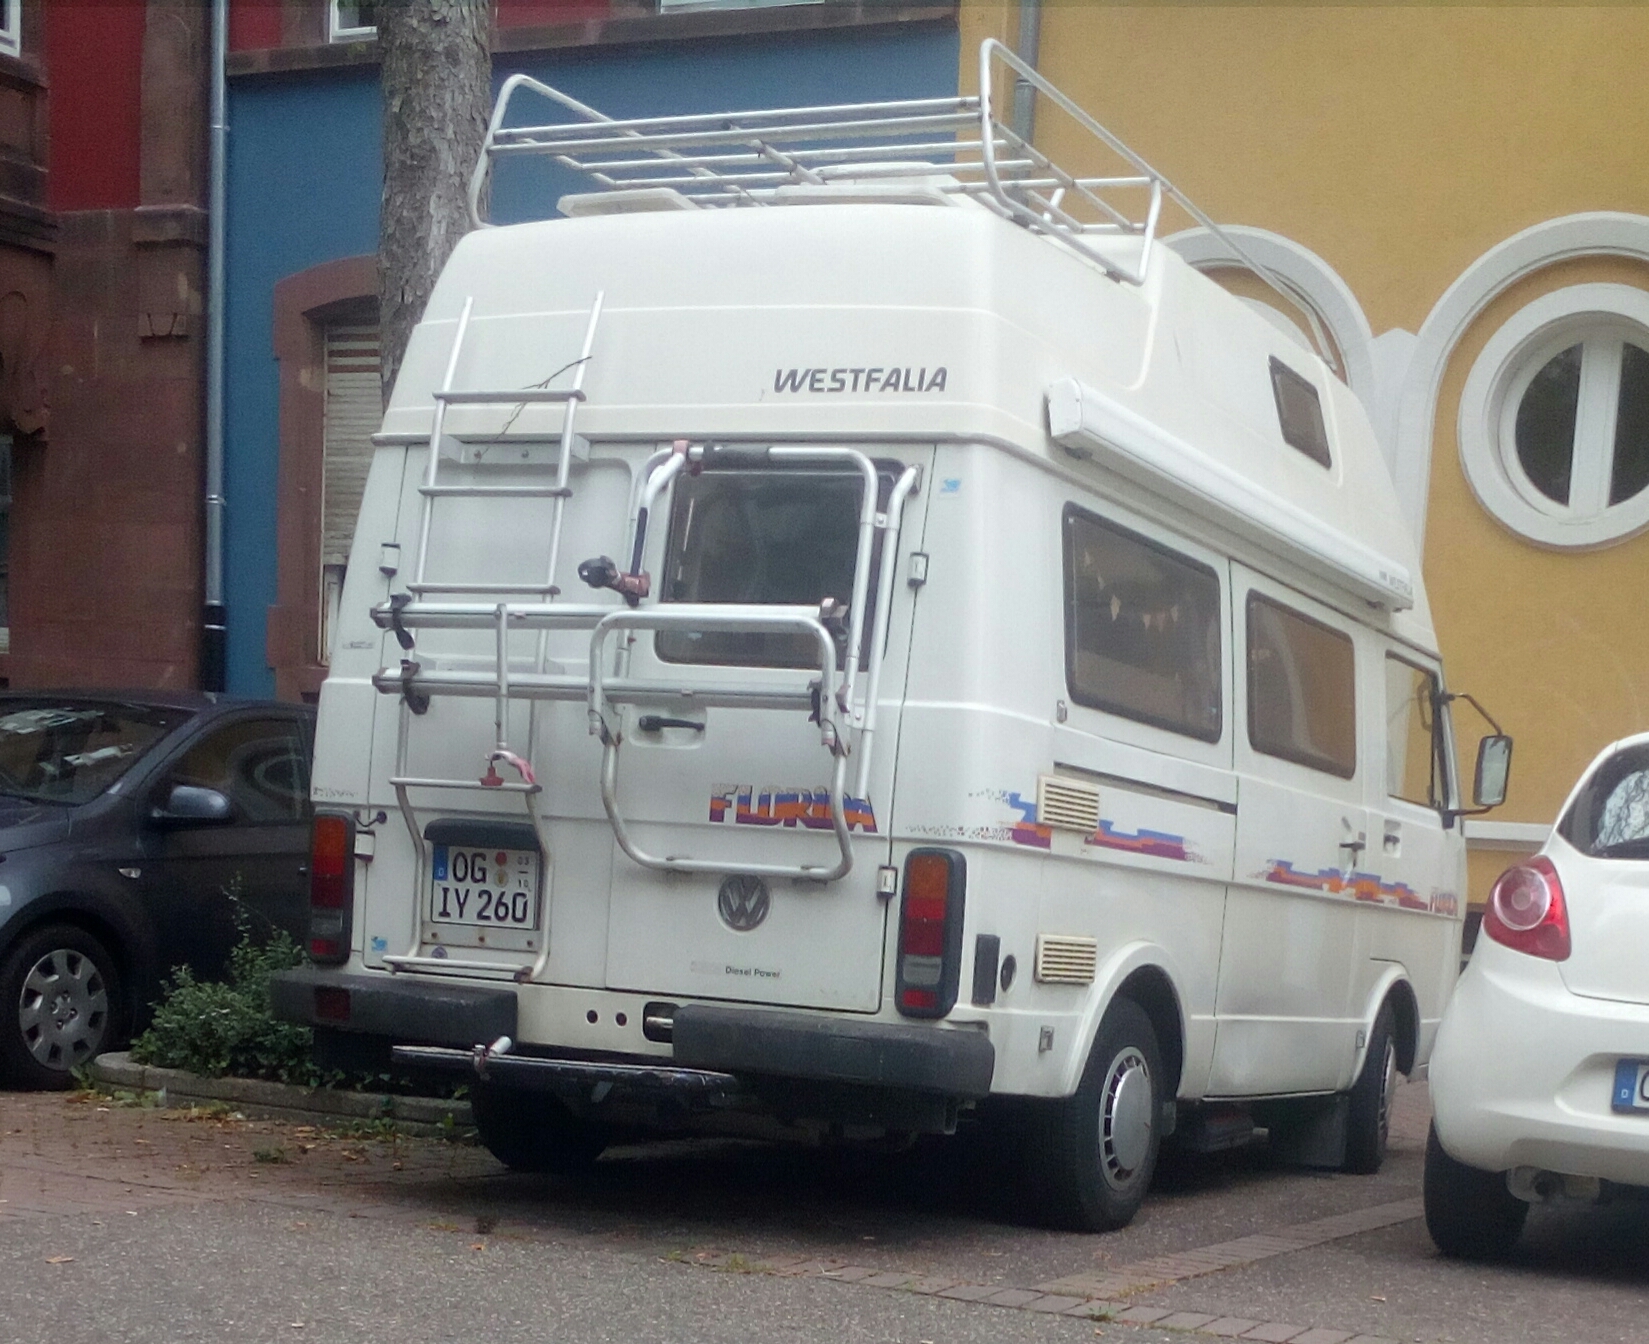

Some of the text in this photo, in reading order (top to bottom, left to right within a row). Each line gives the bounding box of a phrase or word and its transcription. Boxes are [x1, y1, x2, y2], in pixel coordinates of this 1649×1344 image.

[774, 367, 948, 393] WESTFALIA
[438, 867, 445, 877] D
[452, 851, 487, 884] OG
[438, 887, 529, 923] IY 260
[725, 966, 780, 979] Diesel Power
[1621, 1088, 1629, 1099] D
